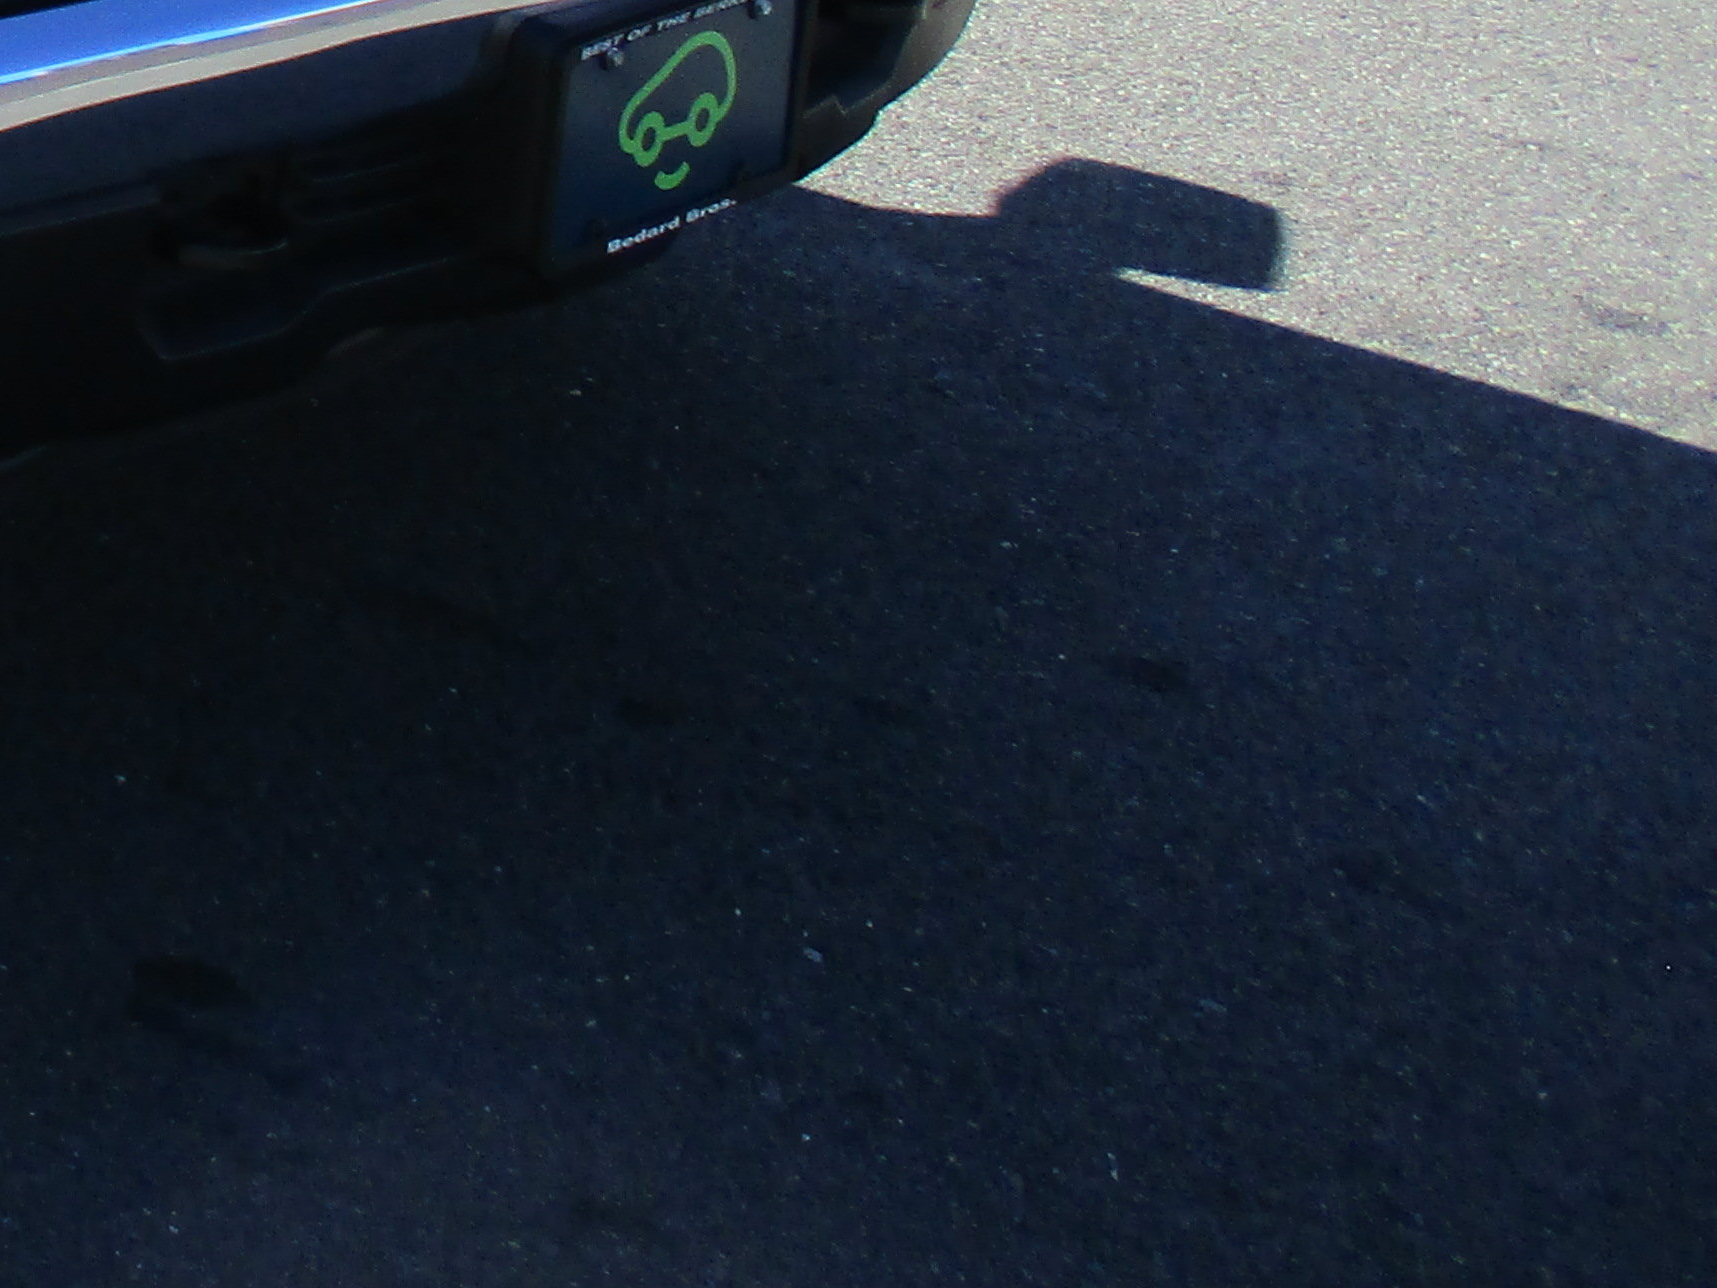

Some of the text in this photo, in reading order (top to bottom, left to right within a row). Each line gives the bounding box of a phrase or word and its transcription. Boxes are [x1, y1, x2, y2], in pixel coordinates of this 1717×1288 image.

[656, 11, 691, 31] THE
[606, 198, 737, 255] Bedard Bros.
